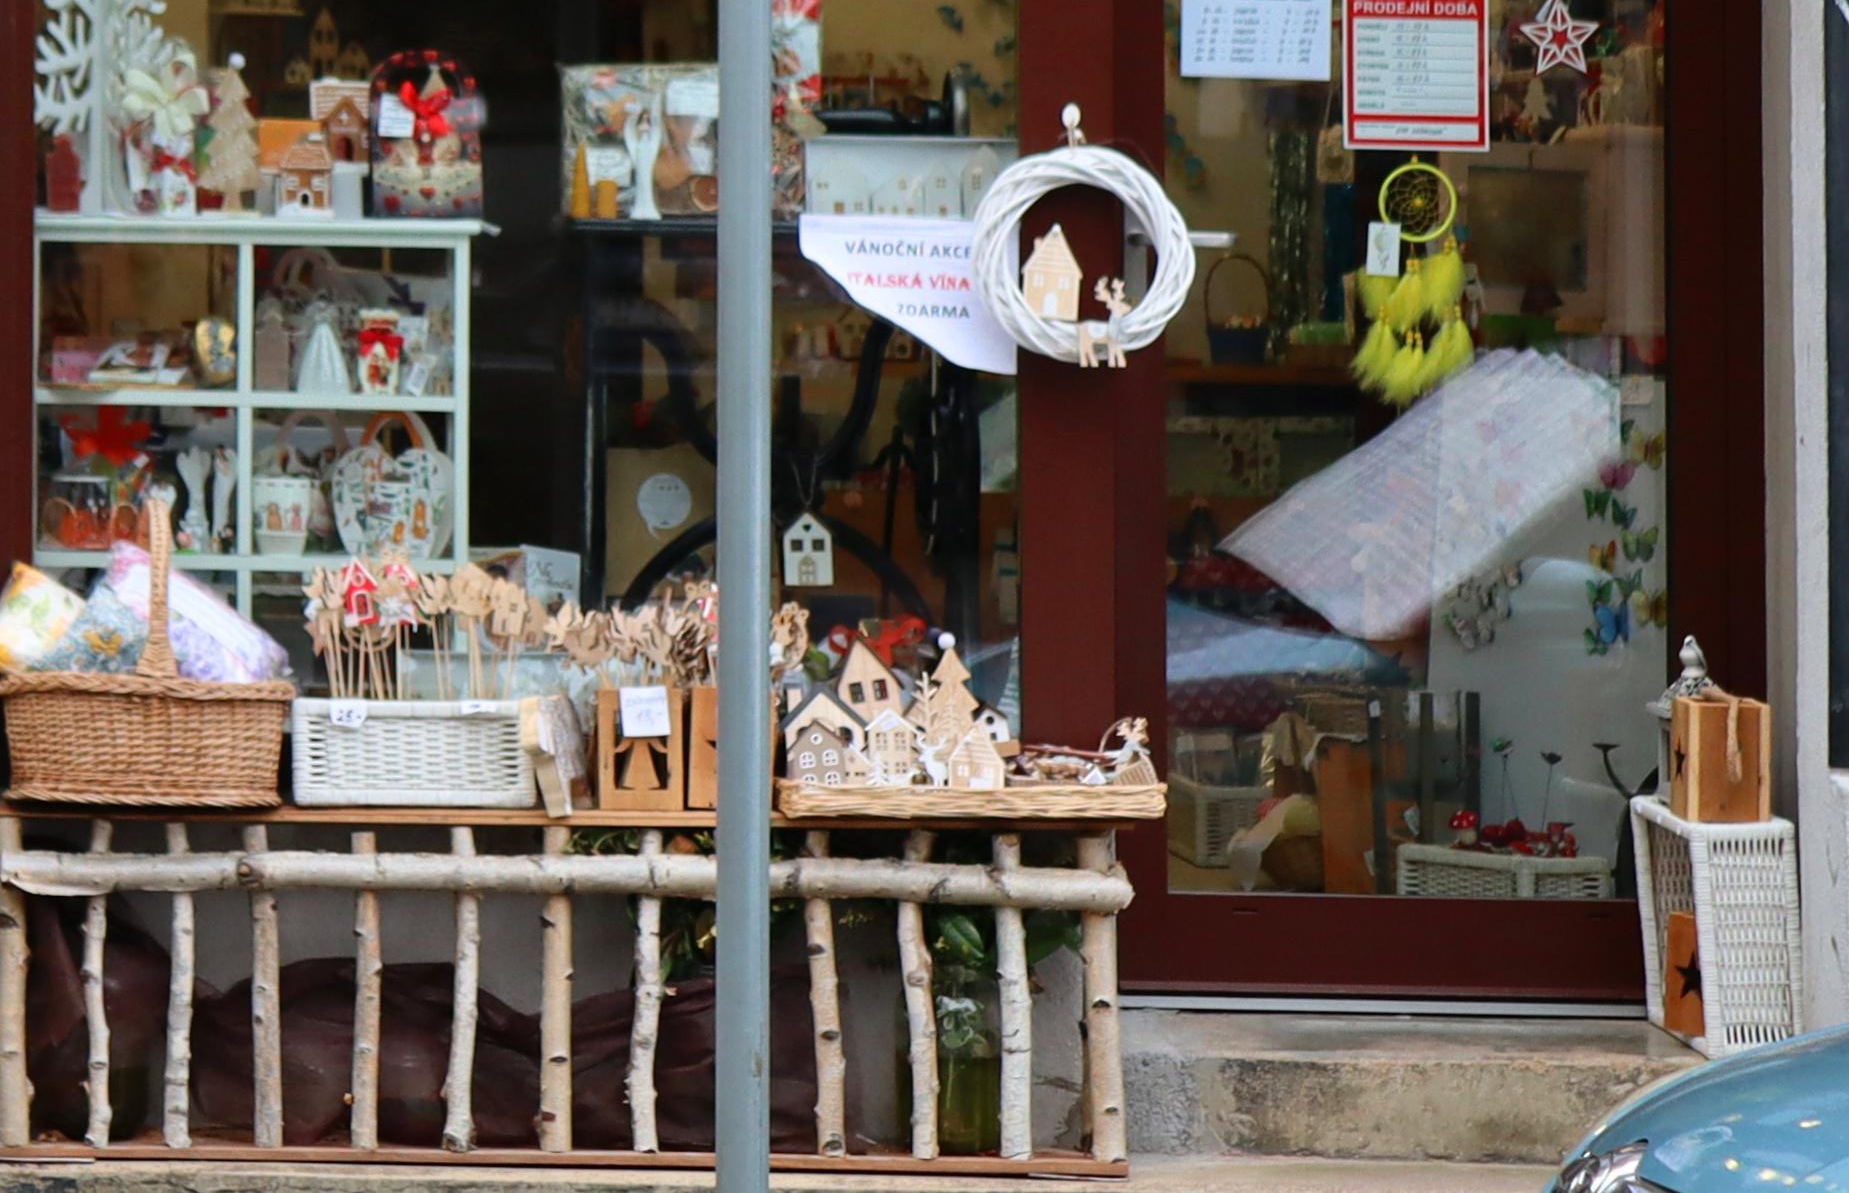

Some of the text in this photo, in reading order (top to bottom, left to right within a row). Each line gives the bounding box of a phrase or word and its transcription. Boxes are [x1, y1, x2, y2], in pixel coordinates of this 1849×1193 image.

[1434, 1, 1478, 16] DOBA
[845, 238, 924, 258] VÁNOČNÍ
[929, 272, 971, 291] VÍNA
[897, 303, 970, 319] ZDARMA
